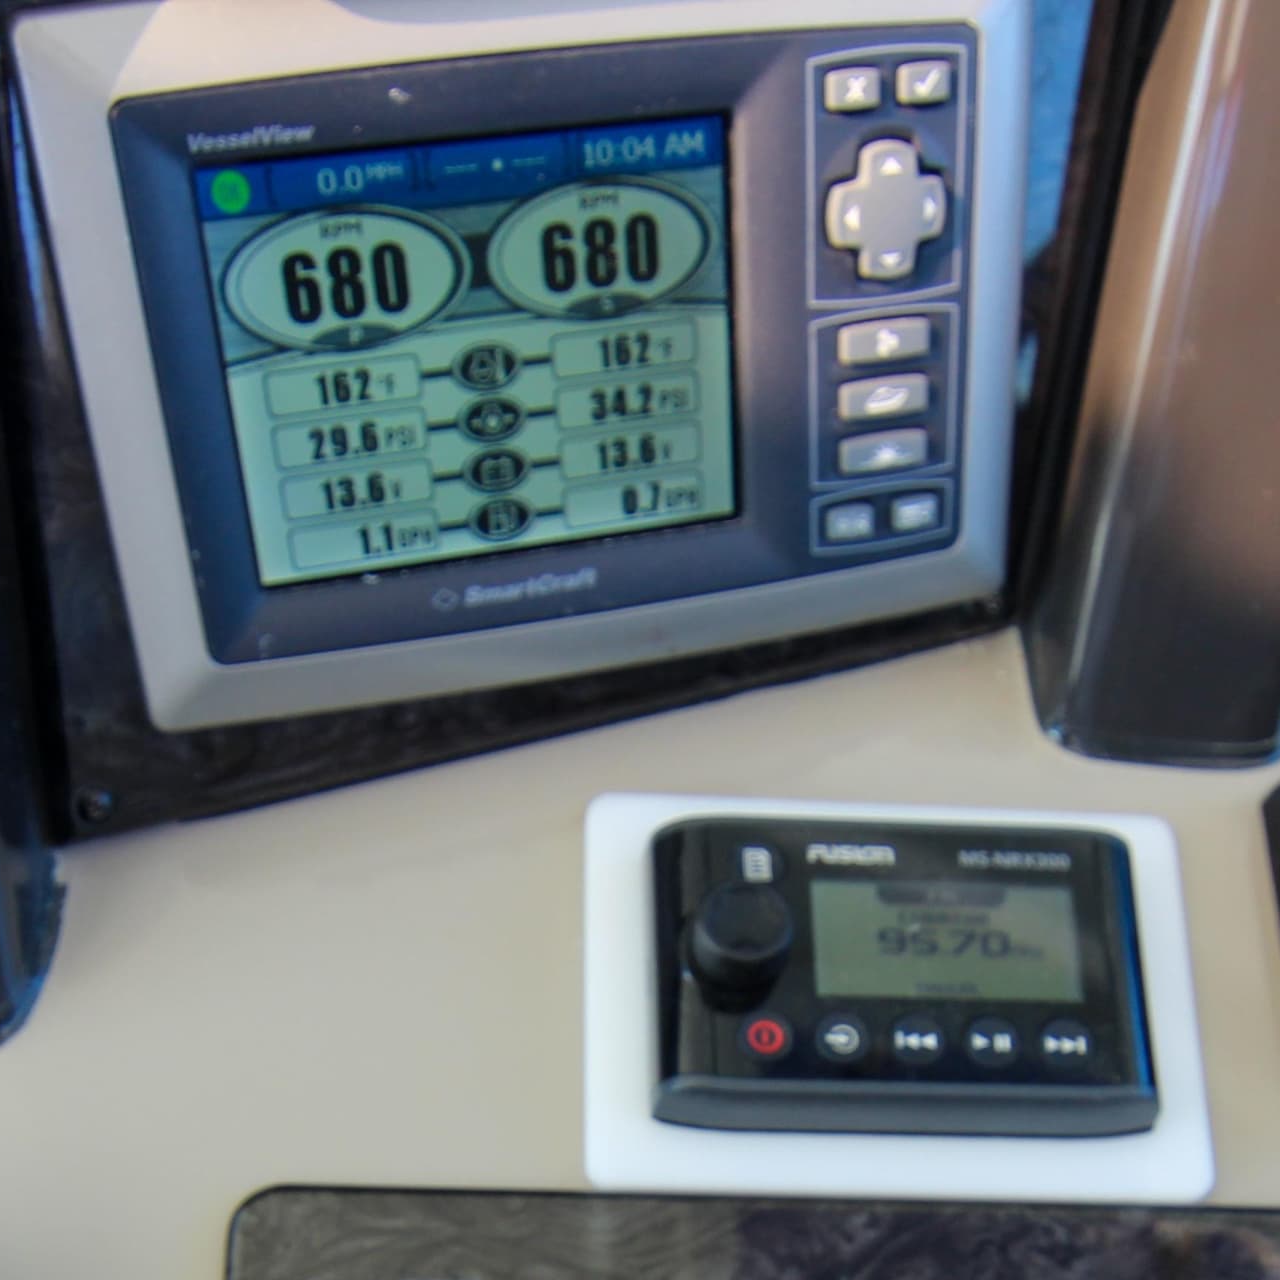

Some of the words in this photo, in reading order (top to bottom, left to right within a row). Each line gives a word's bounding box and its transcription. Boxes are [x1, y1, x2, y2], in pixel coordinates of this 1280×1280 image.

[187, 124, 316, 154] VesselView
[583, 135, 656, 169] 10:04
[663, 128, 707, 157] AM
[317, 164, 364, 197] 0.0
[541, 212, 660, 293] 680
[281, 240, 412, 325] 680
[599, 331, 650, 369] 162
[316, 367, 374, 407] 162
[590, 382, 653, 422] 34.2
[308, 419, 379, 461] 29.6
[598, 431, 655, 470] 13.6
[322, 470, 385, 511] 13.6
[622, 480, 662, 516] 0.7
[358, 521, 394, 555] 1.1
[463, 567, 598, 609] SmartCraft
